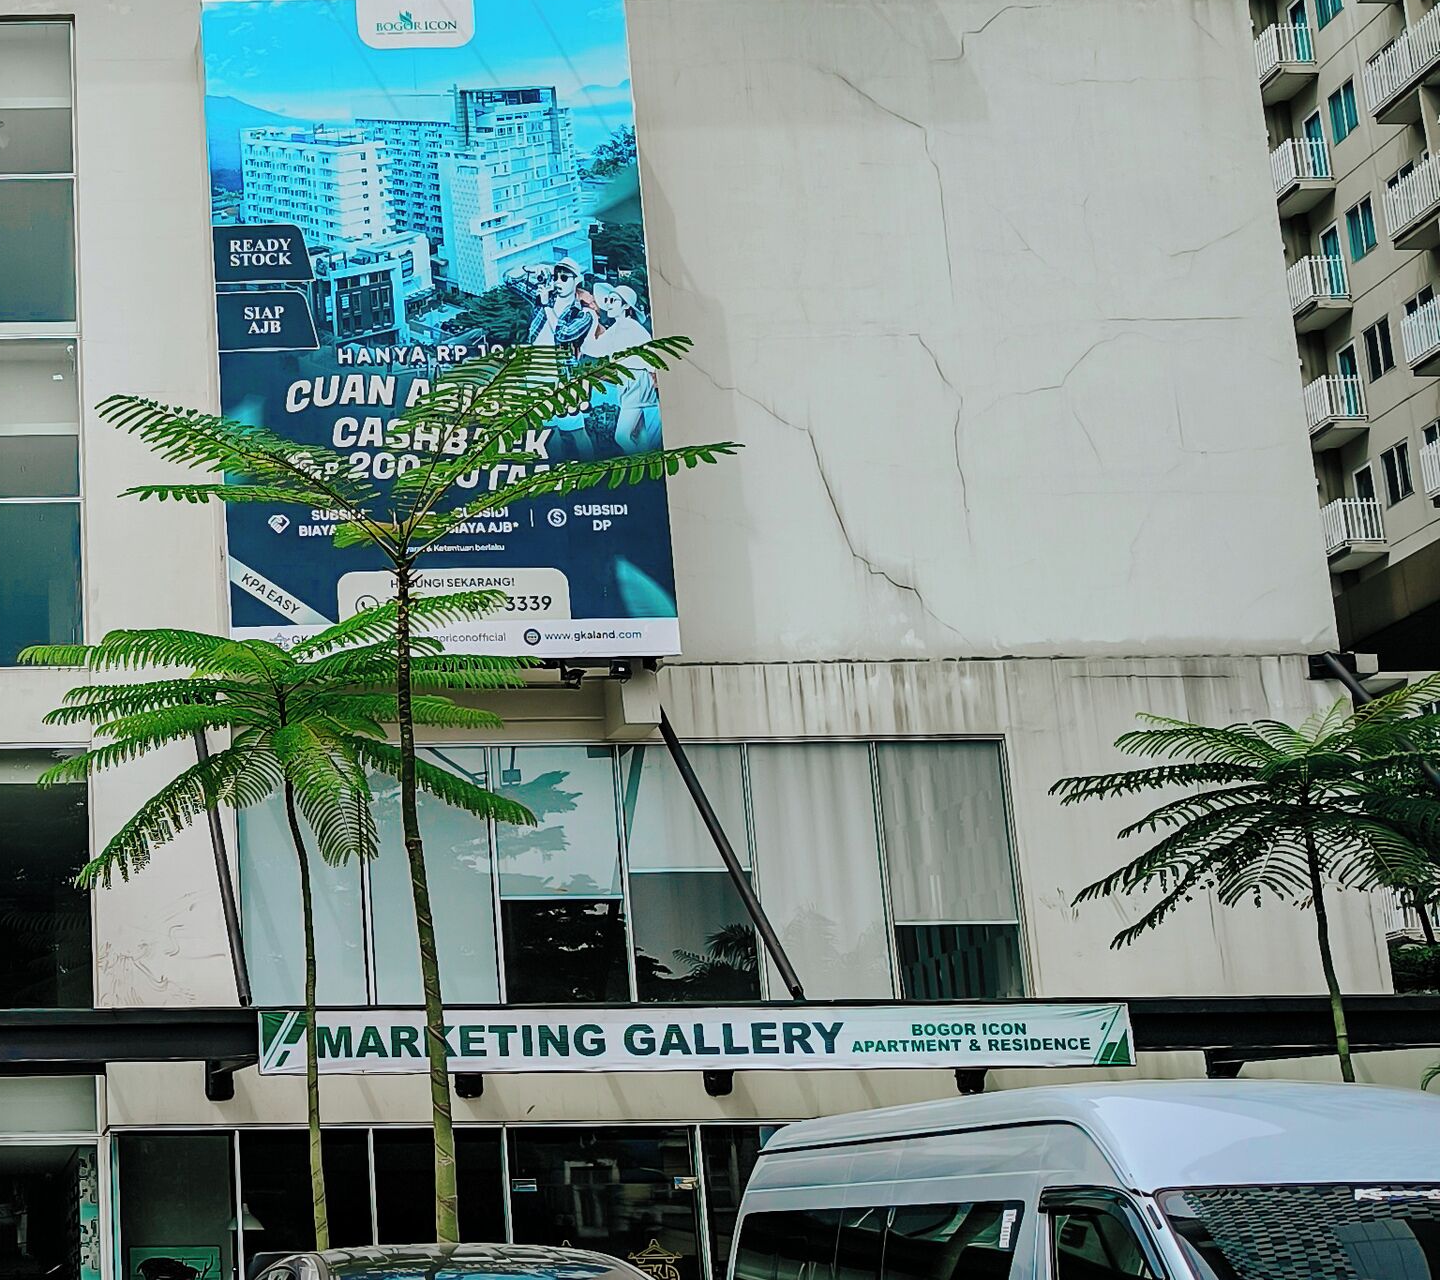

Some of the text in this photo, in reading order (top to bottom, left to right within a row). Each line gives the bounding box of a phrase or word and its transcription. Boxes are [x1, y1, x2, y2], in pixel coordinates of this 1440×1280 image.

[376, 20, 457, 31] BOGOR ICON
[230, 239, 291, 252] READY
[230, 252, 292, 266] STOCK
[244, 306, 284, 320] SIAP
[248, 320, 281, 334] AJB
[337, 346, 427, 365] HANYA
[437, 345, 468, 362] RP
[285, 374, 396, 413] CUAN
[573, 505, 628, 517] SUBSIDI
[593, 519, 612, 532] DP
[391, 577, 516, 588] HBUNGI SEKARANG!
[241, 573, 301, 615] KPA EASY
[544, 630, 642, 642] www.gkaland.com
[911, 1023, 1027, 1036] BOGOR ICON
[316, 1021, 844, 1058] MARKETING GALLERY
[852, 1037, 1091, 1052] APARTMENT & RESIDENCE
